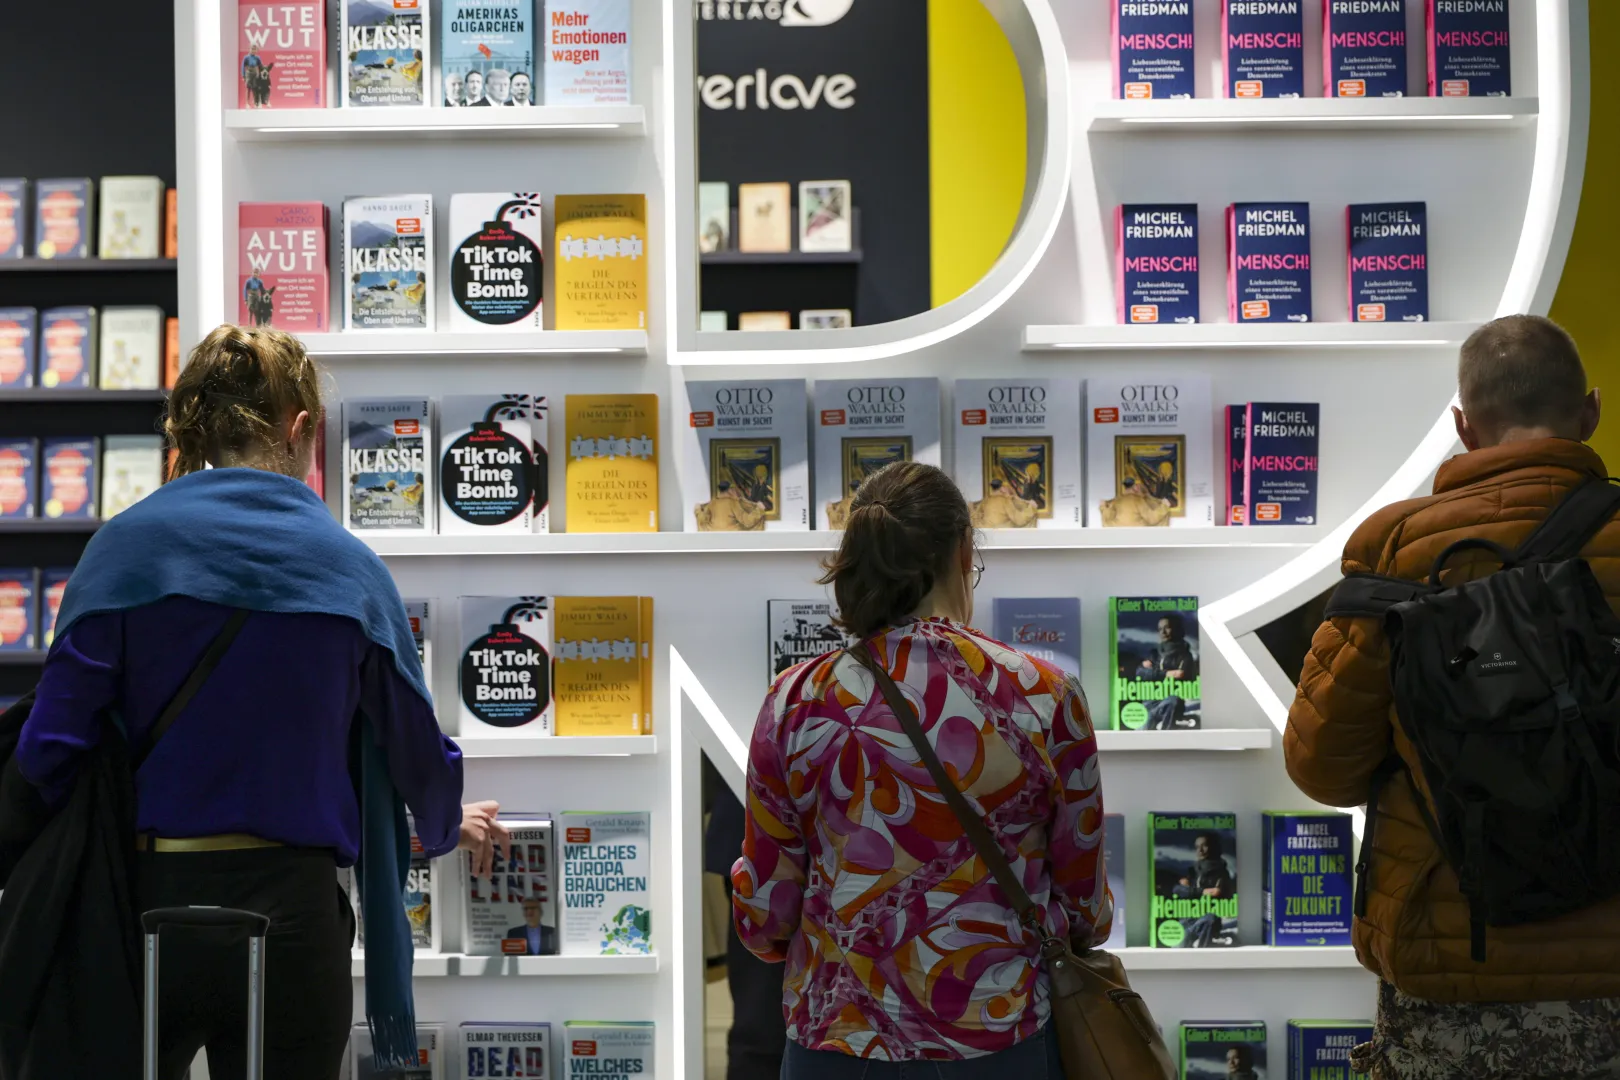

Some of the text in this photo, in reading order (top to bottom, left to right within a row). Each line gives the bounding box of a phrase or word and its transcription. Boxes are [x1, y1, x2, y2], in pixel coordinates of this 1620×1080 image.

[457, 8, 518, 20] AMERIKAS
[694, 1, 782, 20] ERLAG
[1122, 3, 1188, 16] FRIEDMAN
[1230, 2, 1297, 15] FRIEDMAN
[1333, 1, 1400, 14] FRIEDMAN
[1437, 1, 1503, 13] FRIEDMAN
[245, 6, 315, 27] ALTE
[552, 11, 589, 26] Mehr
[451, 21, 524, 33] OLIGARCHEN
[245, 28, 315, 48] WUT
[349, 25, 421, 50] KLASSE
[552, 30, 626, 45] Emotionen
[1120, 33, 1193, 50] MENSCH!
[1229, 32, 1301, 49] MENSCH!
[1332, 31, 1404, 48] MENSCH!
[1437, 31, 1508, 47] MENSCH!
[552, 48, 600, 65] wagen
[356, 86, 366, 94] Die
[1134, 212, 1185, 225] MICHEL
[1246, 210, 1297, 223] MICHEL
[1361, 211, 1412, 224] MICHEL
[1126, 226, 1193, 239] FRIEDMAN
[1238, 224, 1305, 237] FRIEDMAN
[1353, 224, 1420, 238] FRIEDMAN
[247, 230, 316, 250] ALTE
[247, 252, 317, 272] WUT
[352, 248, 425, 272] KLASSE
[460, 245, 533, 264] TikTok
[1125, 256, 1197, 273] MENSCH!
[1237, 254, 1310, 271] MENSCH!
[1352, 254, 1425, 272] MENSCH!
[470, 263, 524, 281] Time
[592, 269, 611, 279] DIE
[467, 280, 529, 298] Bomb
[573, 280, 615, 290] REGELN
[618, 280, 637, 289] DES
[566, 291, 638, 301] VERTRAUENS
[364, 316, 380, 324] Oben
[382, 316, 394, 324] und
[716, 387, 773, 405] OTTO
[847, 385, 905, 404] OTTO
[988, 386, 1046, 404] OTTO
[1121, 384, 1179, 403] OTTO
[716, 404, 774, 416] WAALKES
[848, 403, 905, 414] WAALKES
[989, 402, 1046, 414] WAALKES
[1121, 401, 1179, 413] WAALKES
[717, 417, 740, 426] KUNST
[742, 417, 751, 426] IN
[753, 416, 773, 426] SICHT
[849, 416, 872, 425] KUNST
[874, 416, 883, 424] IN
[885, 415, 904, 424] SICHT
[990, 414, 1013, 425] KUNST
[1015, 414, 1024, 424] IN
[1025, 414, 1046, 424] SICHT
[1122, 413, 1146, 423] KUNST
[1147, 413, 1156, 423] IN
[1158, 412, 1178, 422] SICHT
[1262, 411, 1308, 424] MICHEL
[1253, 424, 1315, 437] FRIEDMAN
[350, 449, 423, 473] KLASSE
[450, 446, 522, 464] TikTok
[1252, 455, 1319, 472] MENSCH!
[460, 464, 513, 482] Time
[602, 470, 620, 479] DIE
[457, 481, 518, 498] Bomb
[584, 481, 625, 490] REGELN
[628, 481, 648, 490] DES
[577, 491, 648, 500] VERTRAUENS
[357, 509, 367, 517] Die
[561, 613, 592, 622] JIMMY
[800, 623, 822, 639] DIE
[469, 649, 540, 667] TikTok
[1481, 660, 1517, 669] VICTORINOX
[478, 666, 532, 683] Time
[586, 672, 602, 681] DIE
[476, 683, 537, 701] Bomb
[568, 683, 630, 692] REGELN DES
[1117, 676, 1200, 700] Heimatland
[561, 694, 631, 703] VERTRAUENS
[585, 818, 646, 827] Gerald Knaus
[1296, 824, 1329, 836] MARCEL
[510, 831, 545, 840] EVESSEN
[1287, 836, 1339, 849] FRATZSCHER
[564, 845, 637, 860] WELCHES
[565, 861, 624, 876] EUROPA
[1281, 854, 1345, 874] NACH UNS
[471, 875, 548, 903] LINE
[565, 877, 646, 892] BRAUCHEN
[1303, 876, 1324, 894] DIE
[565, 893, 605, 908] WIR?
[1155, 893, 1238, 918] Heimatland
[1285, 896, 1342, 916] ZUKUNFT
[466, 1032, 542, 1042] ELMAR THEVESSEN
[1325, 1035, 1356, 1047] MARCEL
[467, 1047, 544, 1077] DEAD
[1316, 1048, 1351, 1061] FRATZSC
[571, 1058, 643, 1074] WELCHES
[1310, 1067, 1344, 1080] NACH
